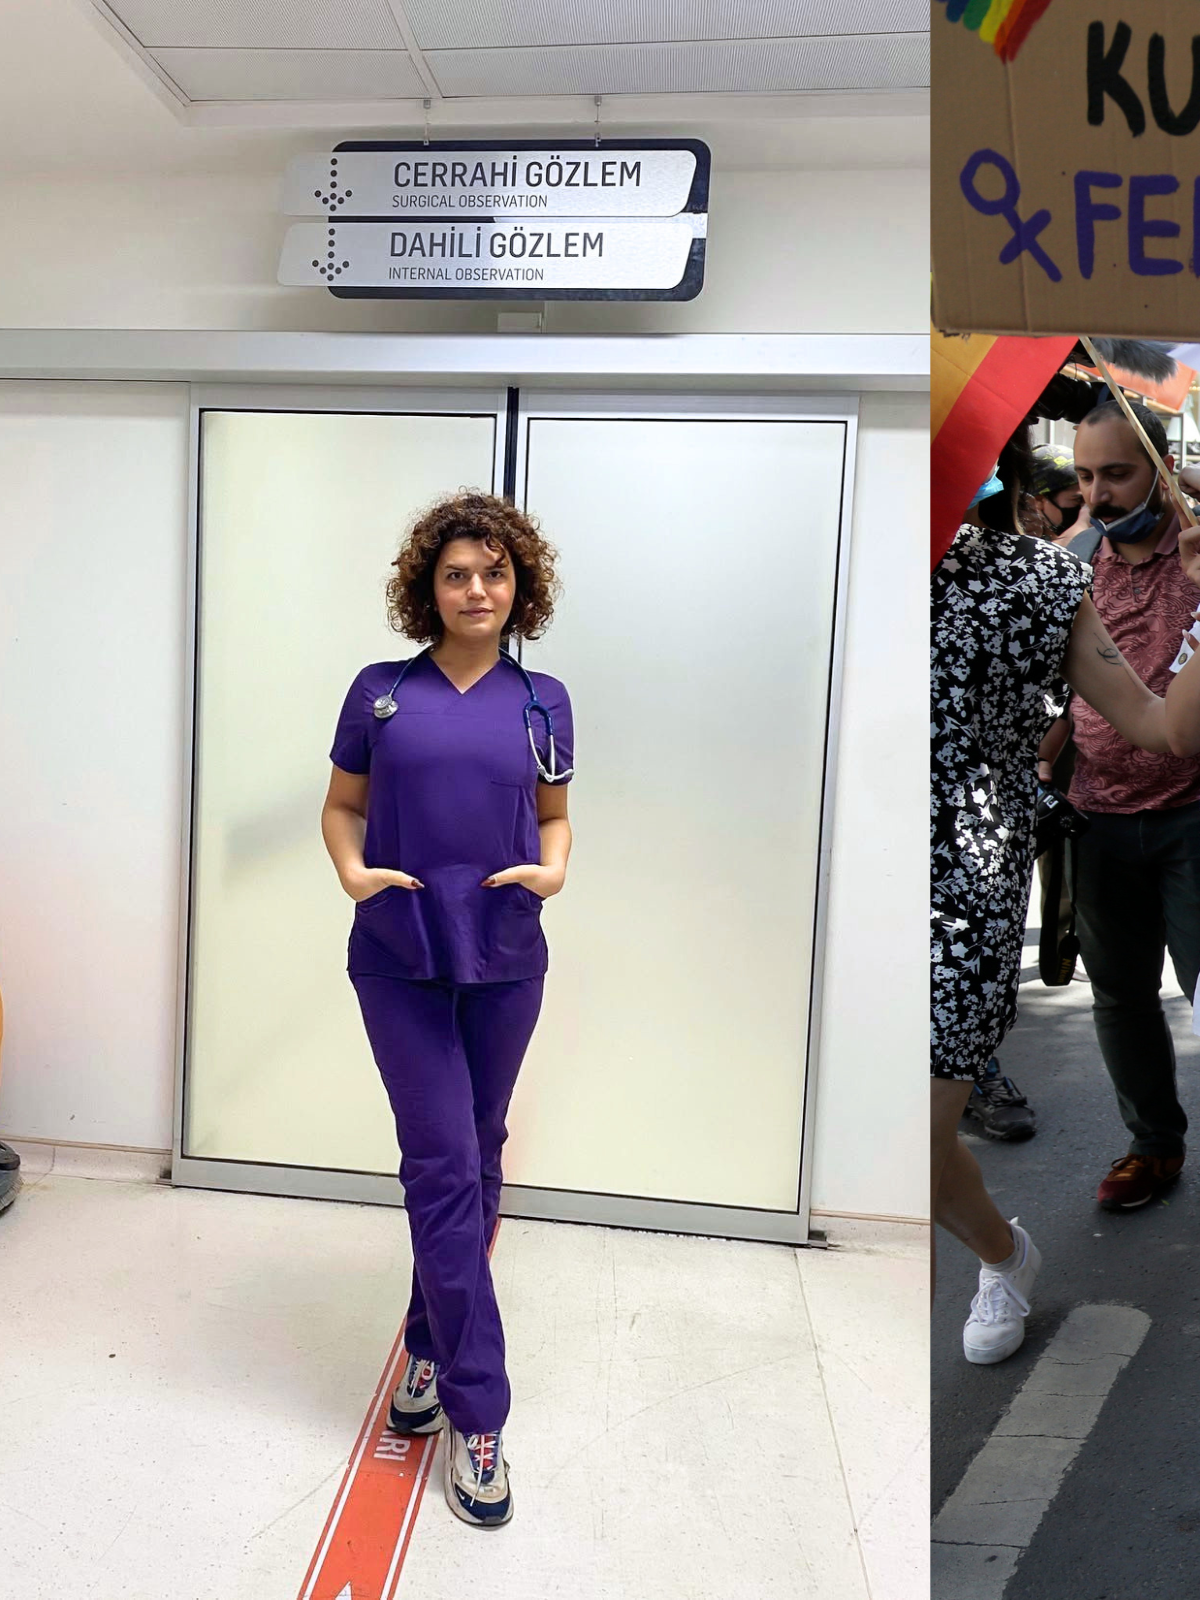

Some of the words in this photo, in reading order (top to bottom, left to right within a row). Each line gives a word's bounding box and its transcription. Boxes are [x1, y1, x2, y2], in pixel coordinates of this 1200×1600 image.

[393, 155, 518, 188] CERRAHİ
[525, 155, 642, 188] GÖZLEM
[391, 194, 456, 208] SURGICAL
[458, 194, 548, 209] OBSERVATION
[389, 226, 482, 258] DAHİLİ
[489, 227, 604, 258] GÖZLEM
[388, 267, 452, 281] INTERNAL
[455, 267, 545, 282] OBSERVATION
[373, 1430, 411, 1462] RI
